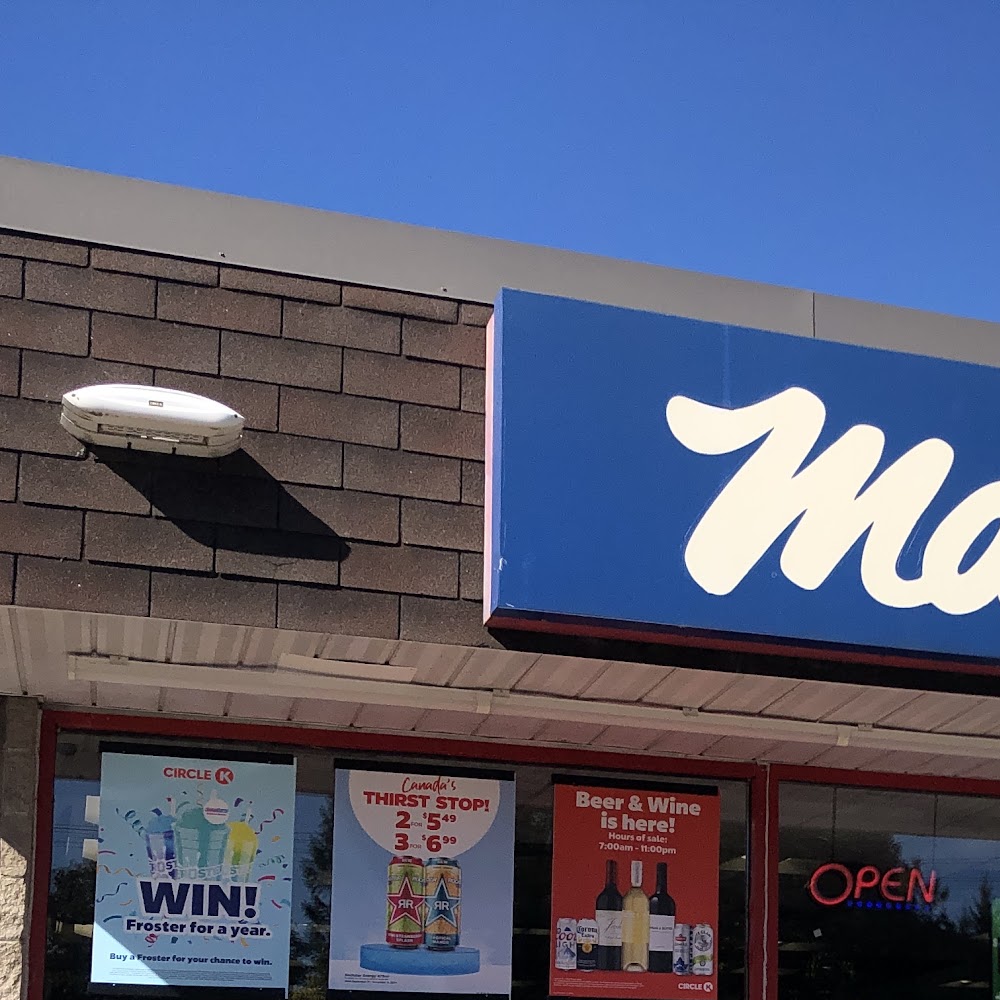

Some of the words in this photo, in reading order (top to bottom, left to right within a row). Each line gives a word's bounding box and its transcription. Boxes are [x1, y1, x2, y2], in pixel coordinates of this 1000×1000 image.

[163, 767, 212, 780] CIRCLE
[217, 768, 233, 784] K
[401, 776, 457, 794] Canada's
[363, 791, 431, 808] THIRST
[435, 796, 490, 812] STOP!
[575, 791, 625, 811] Beer
[628, 795, 643, 812] &
[647, 796, 701, 816] Wine
[395, 810, 411, 829] 2
[600, 811, 618, 829] is
[621, 814, 676, 833] here!
[394, 833, 409, 851] 3
[608, 832, 635, 841] Hours
[636, 833, 646, 841] of
[647, 836, 668, 844] sale:
[599, 842, 633, 851] 7:00am
[641, 844, 676, 855] 11:00pm
[809, 863, 936, 906] OPEN
[139, 880, 258, 919] WIN!
[126, 919, 187, 933] Froster
[189, 921, 214, 934] for
[217, 925, 227, 935] a
[230, 926, 271, 938] year.
[109, 952, 127, 963] Buy
[137, 954, 171, 962] Froster
[172, 955, 185, 963] for
[187, 957, 209, 966] your
[210, 957, 241, 965] chance
[242, 958, 252, 966] to
[253, 958, 273, 966] win.
[678, 982, 703, 991] CIRCLE
